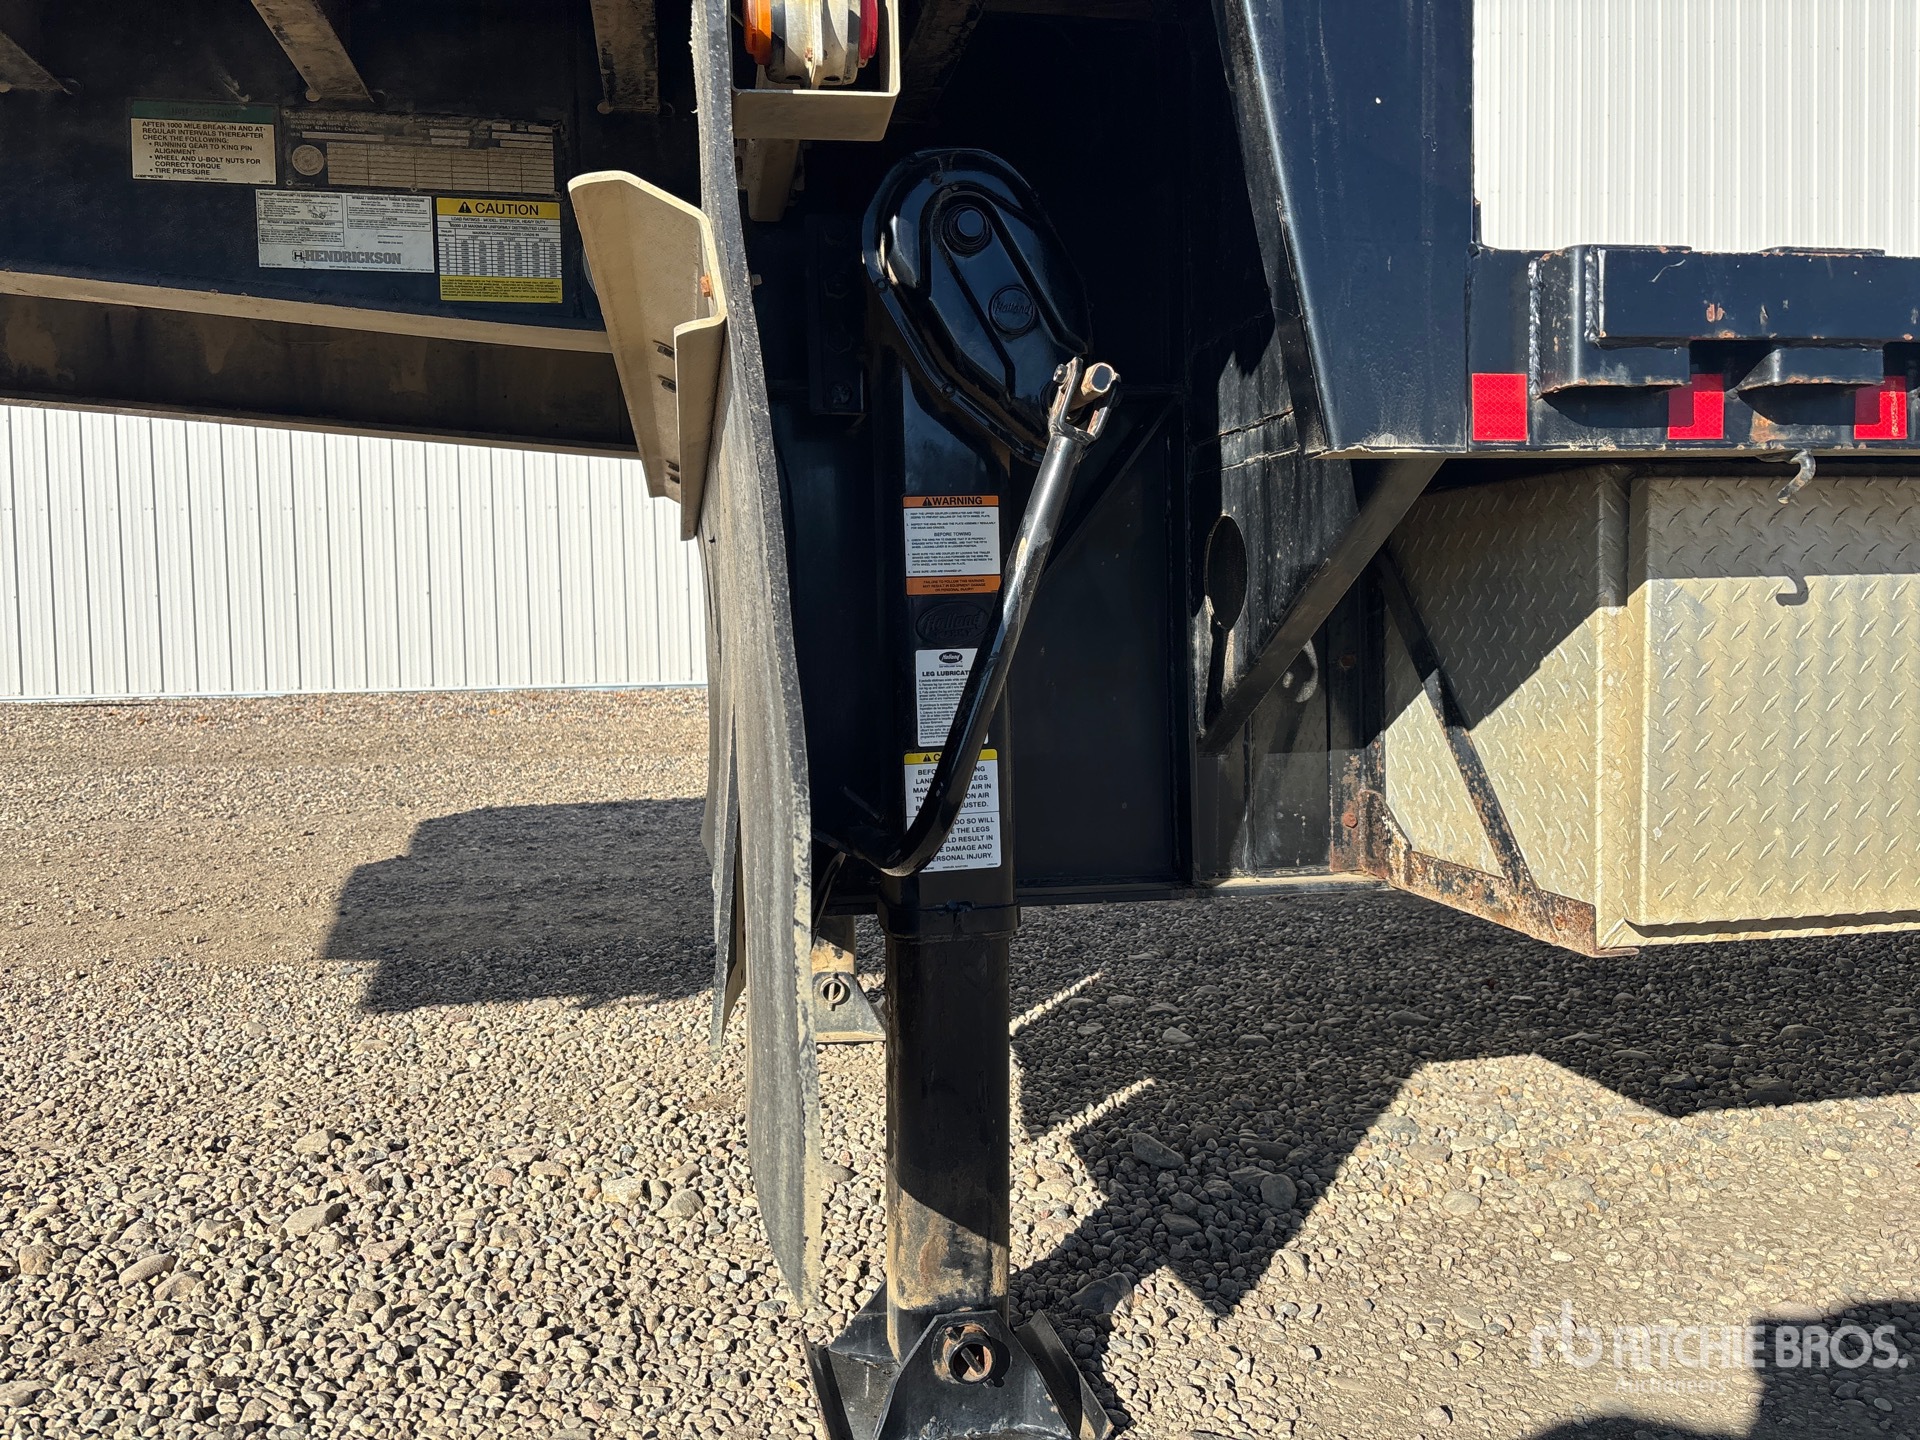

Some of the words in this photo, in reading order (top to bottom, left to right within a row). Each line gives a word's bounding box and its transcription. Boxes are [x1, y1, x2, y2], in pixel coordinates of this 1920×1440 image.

[475, 203, 539, 215] CAUTION
[305, 250, 401, 264] HENDRICKSON
[932, 497, 982, 505] WARNING
